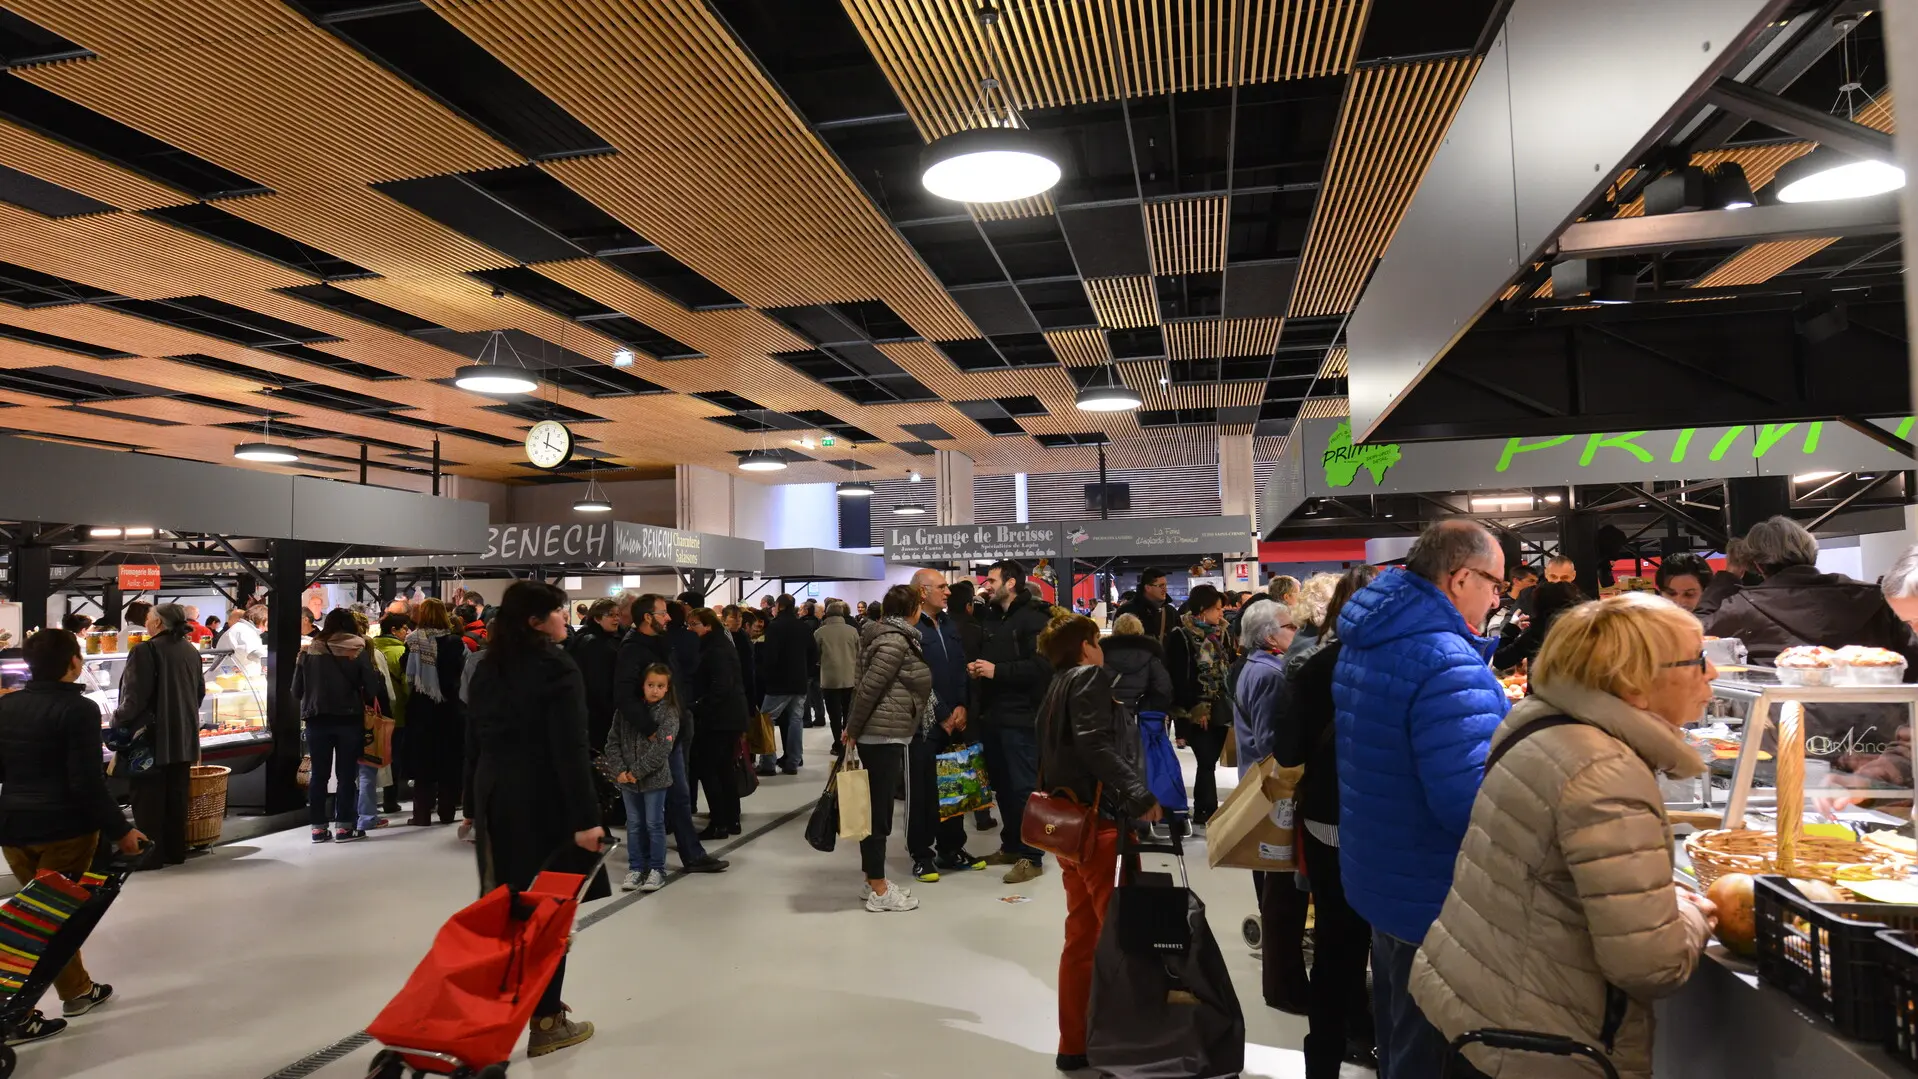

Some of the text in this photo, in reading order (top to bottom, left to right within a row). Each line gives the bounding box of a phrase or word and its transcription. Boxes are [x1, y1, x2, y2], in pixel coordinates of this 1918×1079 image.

[480, 523, 607, 560] BENECH
[642, 528, 672, 560] BENECH
[892, 525, 1053, 549] La Grange de Breisse
